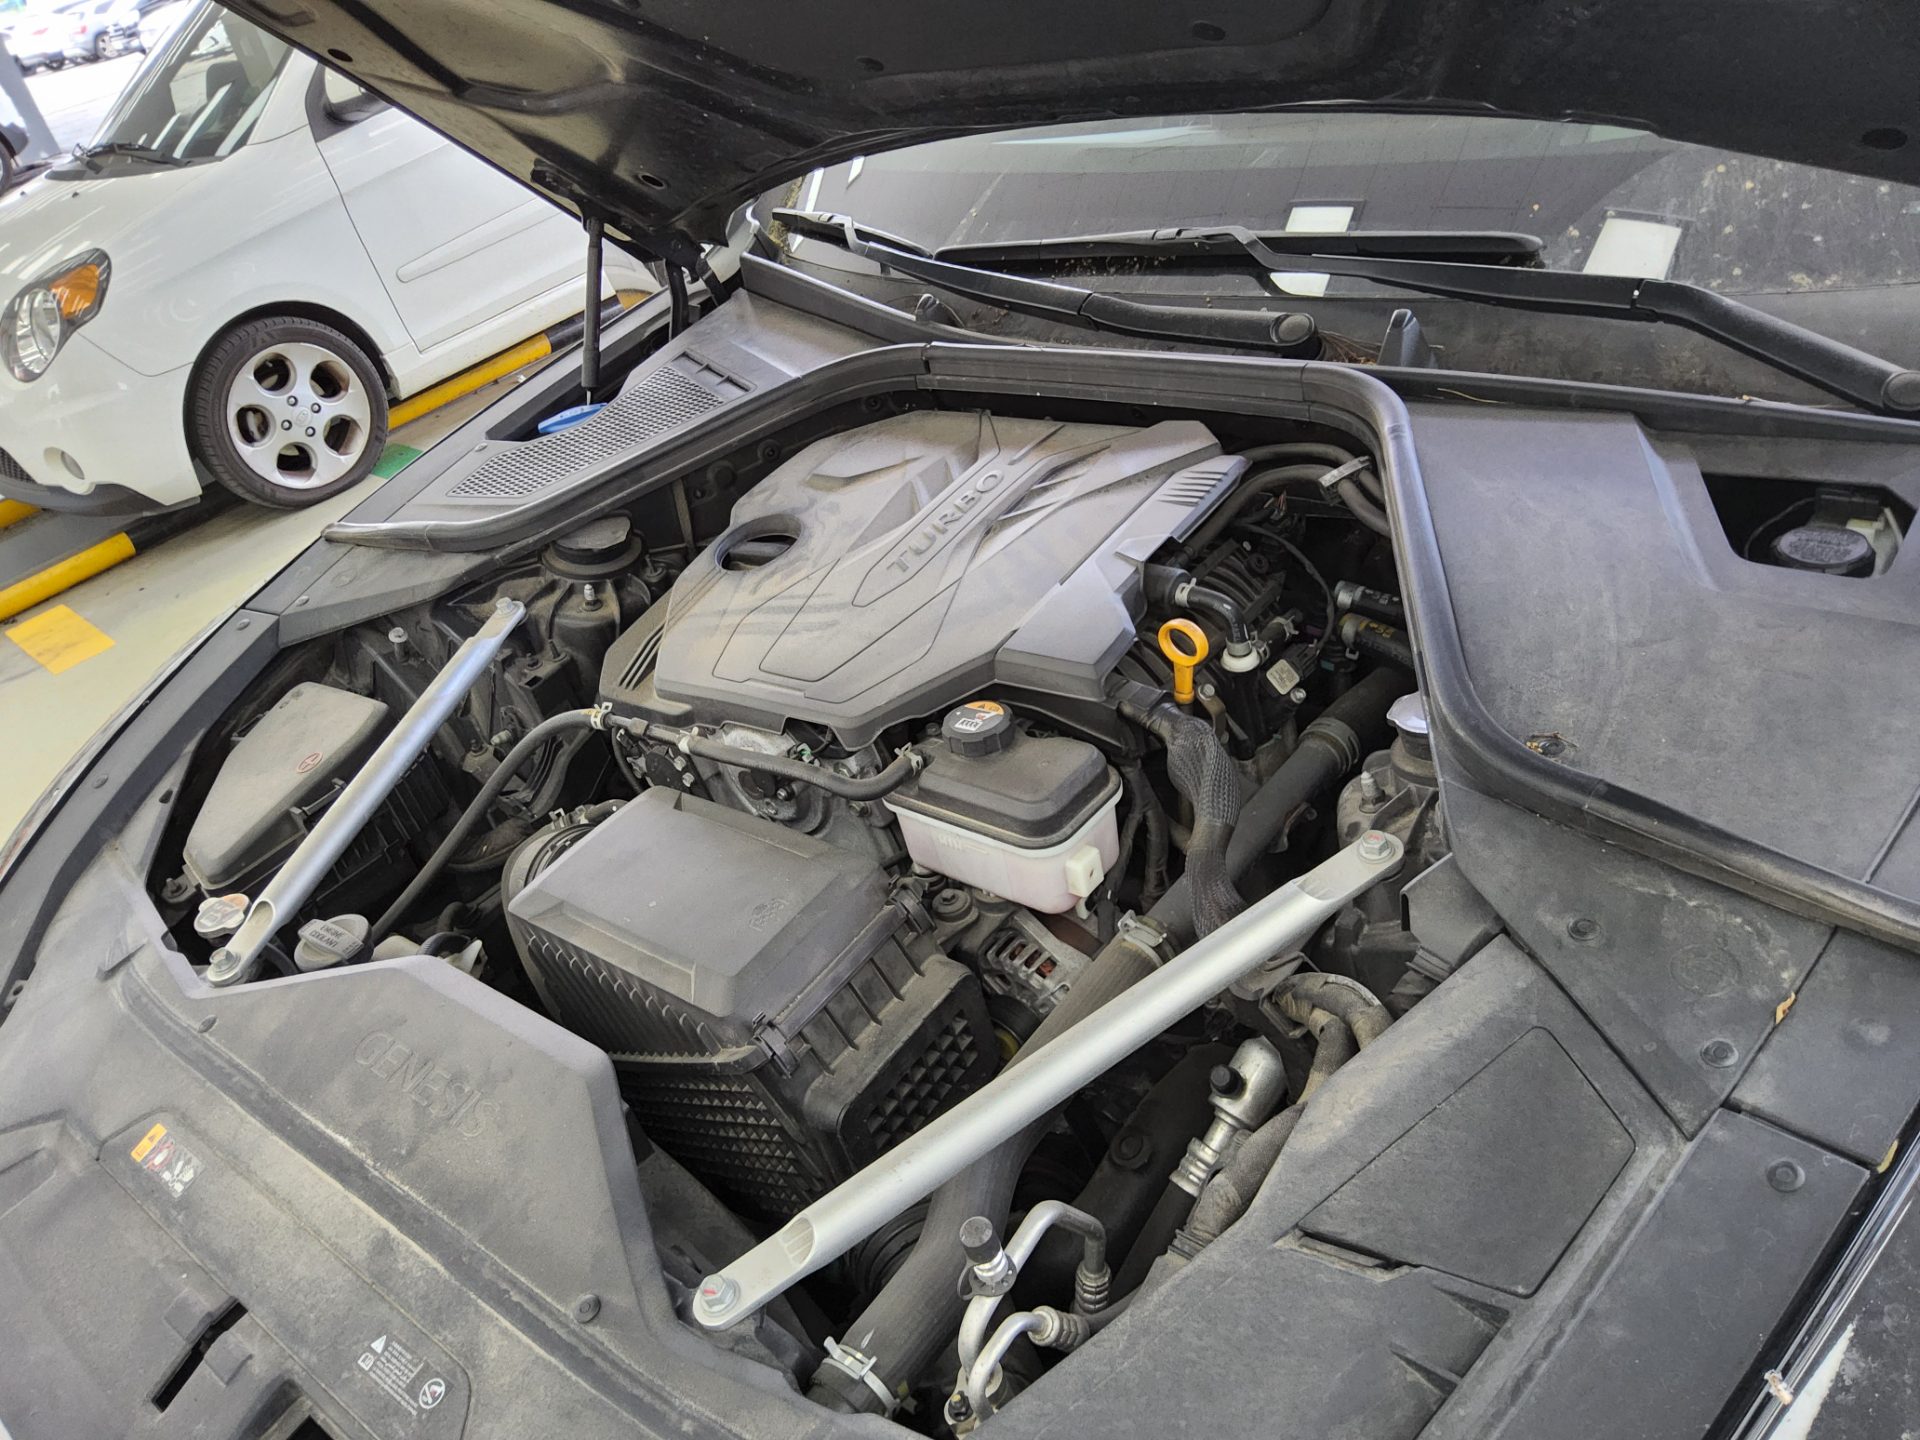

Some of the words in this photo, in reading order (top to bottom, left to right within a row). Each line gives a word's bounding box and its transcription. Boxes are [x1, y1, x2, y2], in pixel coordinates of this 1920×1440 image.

[886, 470, 1004, 573] TURBO
[309, 930, 338, 949] COOLANT
[353, 1029, 501, 1138] GENESIS
